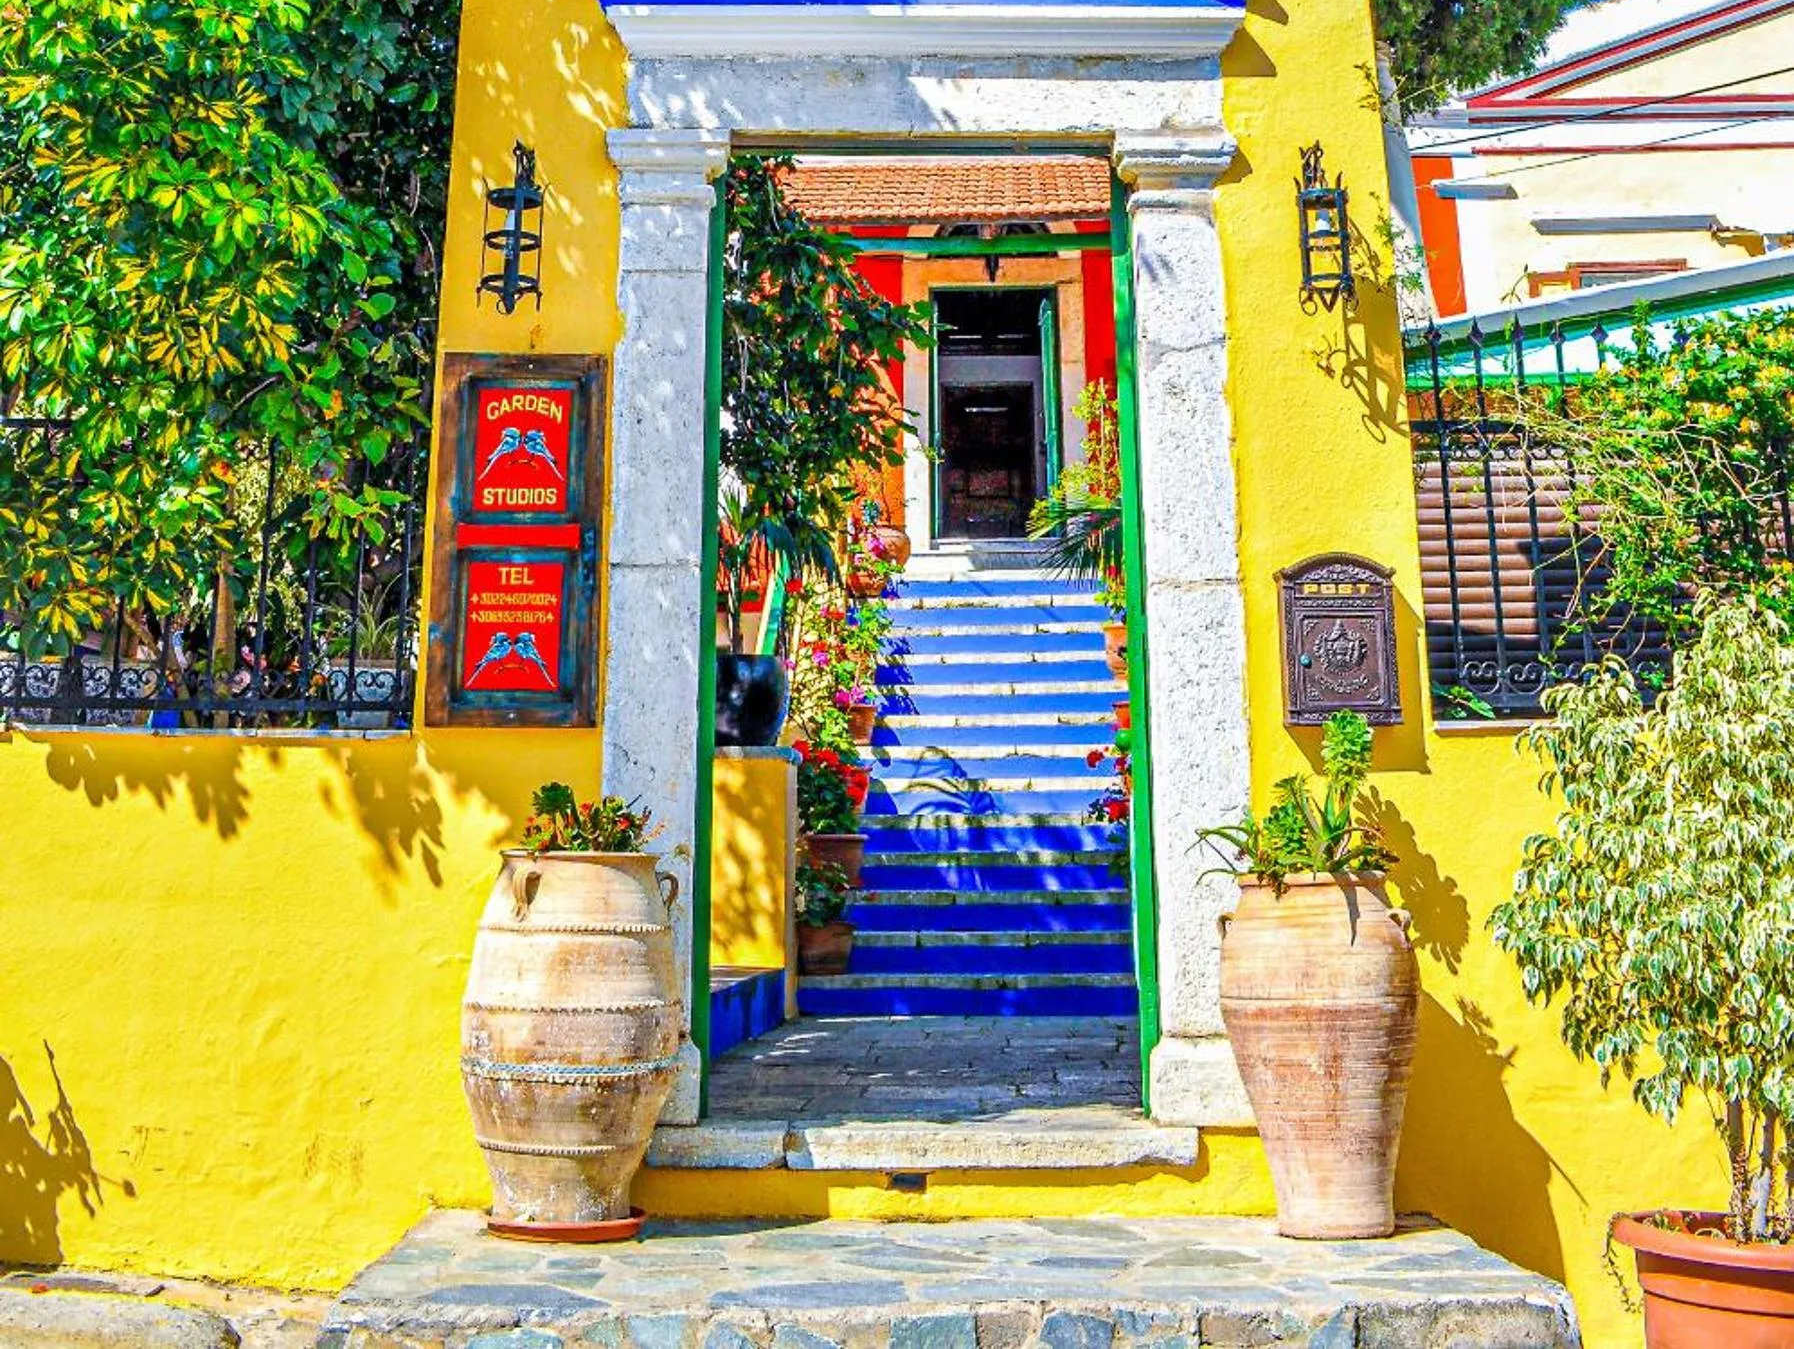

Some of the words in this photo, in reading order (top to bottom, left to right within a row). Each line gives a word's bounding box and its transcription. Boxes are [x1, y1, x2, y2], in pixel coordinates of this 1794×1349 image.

[486, 394, 563, 424] GARDEN
[482, 487, 558, 505] STUDIOS
[497, 567, 535, 585] TEL
[1303, 583, 1371, 594] POST
